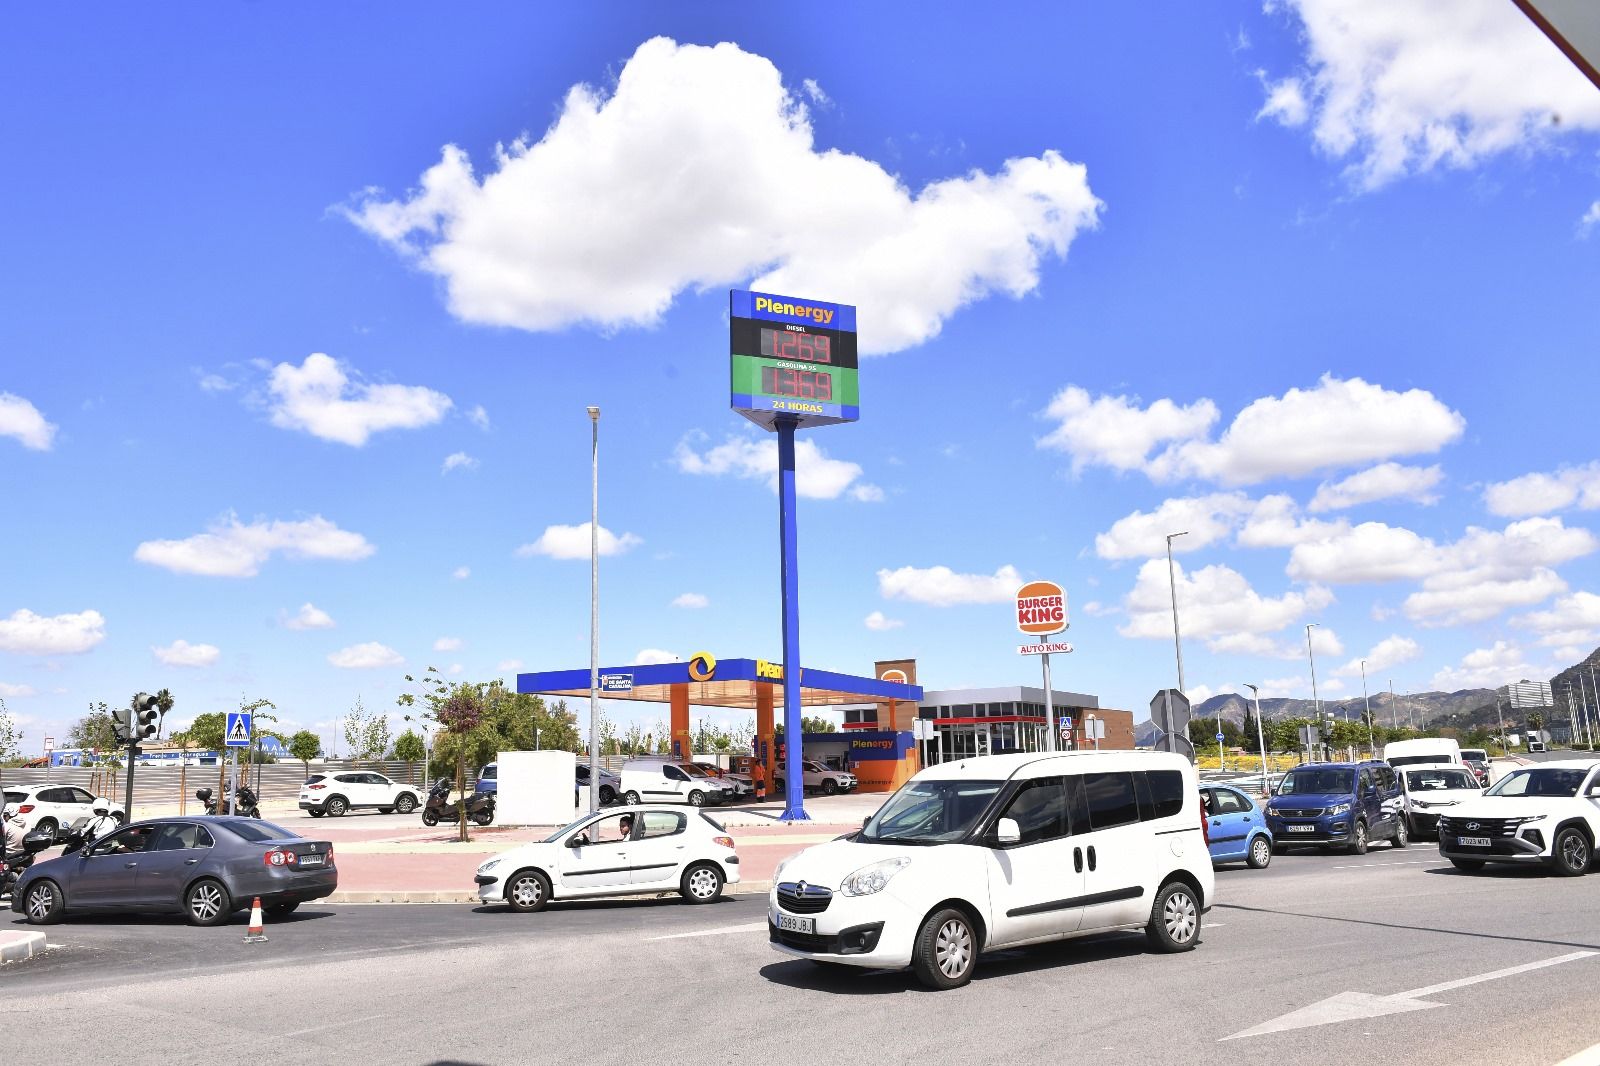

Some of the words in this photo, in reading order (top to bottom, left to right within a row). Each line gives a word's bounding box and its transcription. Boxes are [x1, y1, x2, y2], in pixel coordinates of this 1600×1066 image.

[756, 297, 834, 324] Plenergy
[786, 324, 806, 333] DIESEL
[777, 361, 808, 370] GASOLINA
[772, 400, 785, 409] 24
[788, 402, 823, 413] HORAS
[1017, 596, 1063, 610] BURGER
[1018, 607, 1064, 624] KING
[1020, 644, 1045, 654] AUTO
[1045, 643, 1068, 653] KING
[852, 740, 893, 749] Plenergy
[780, 916, 797, 930] 2589
[798, 919, 812, 932] JBJ
